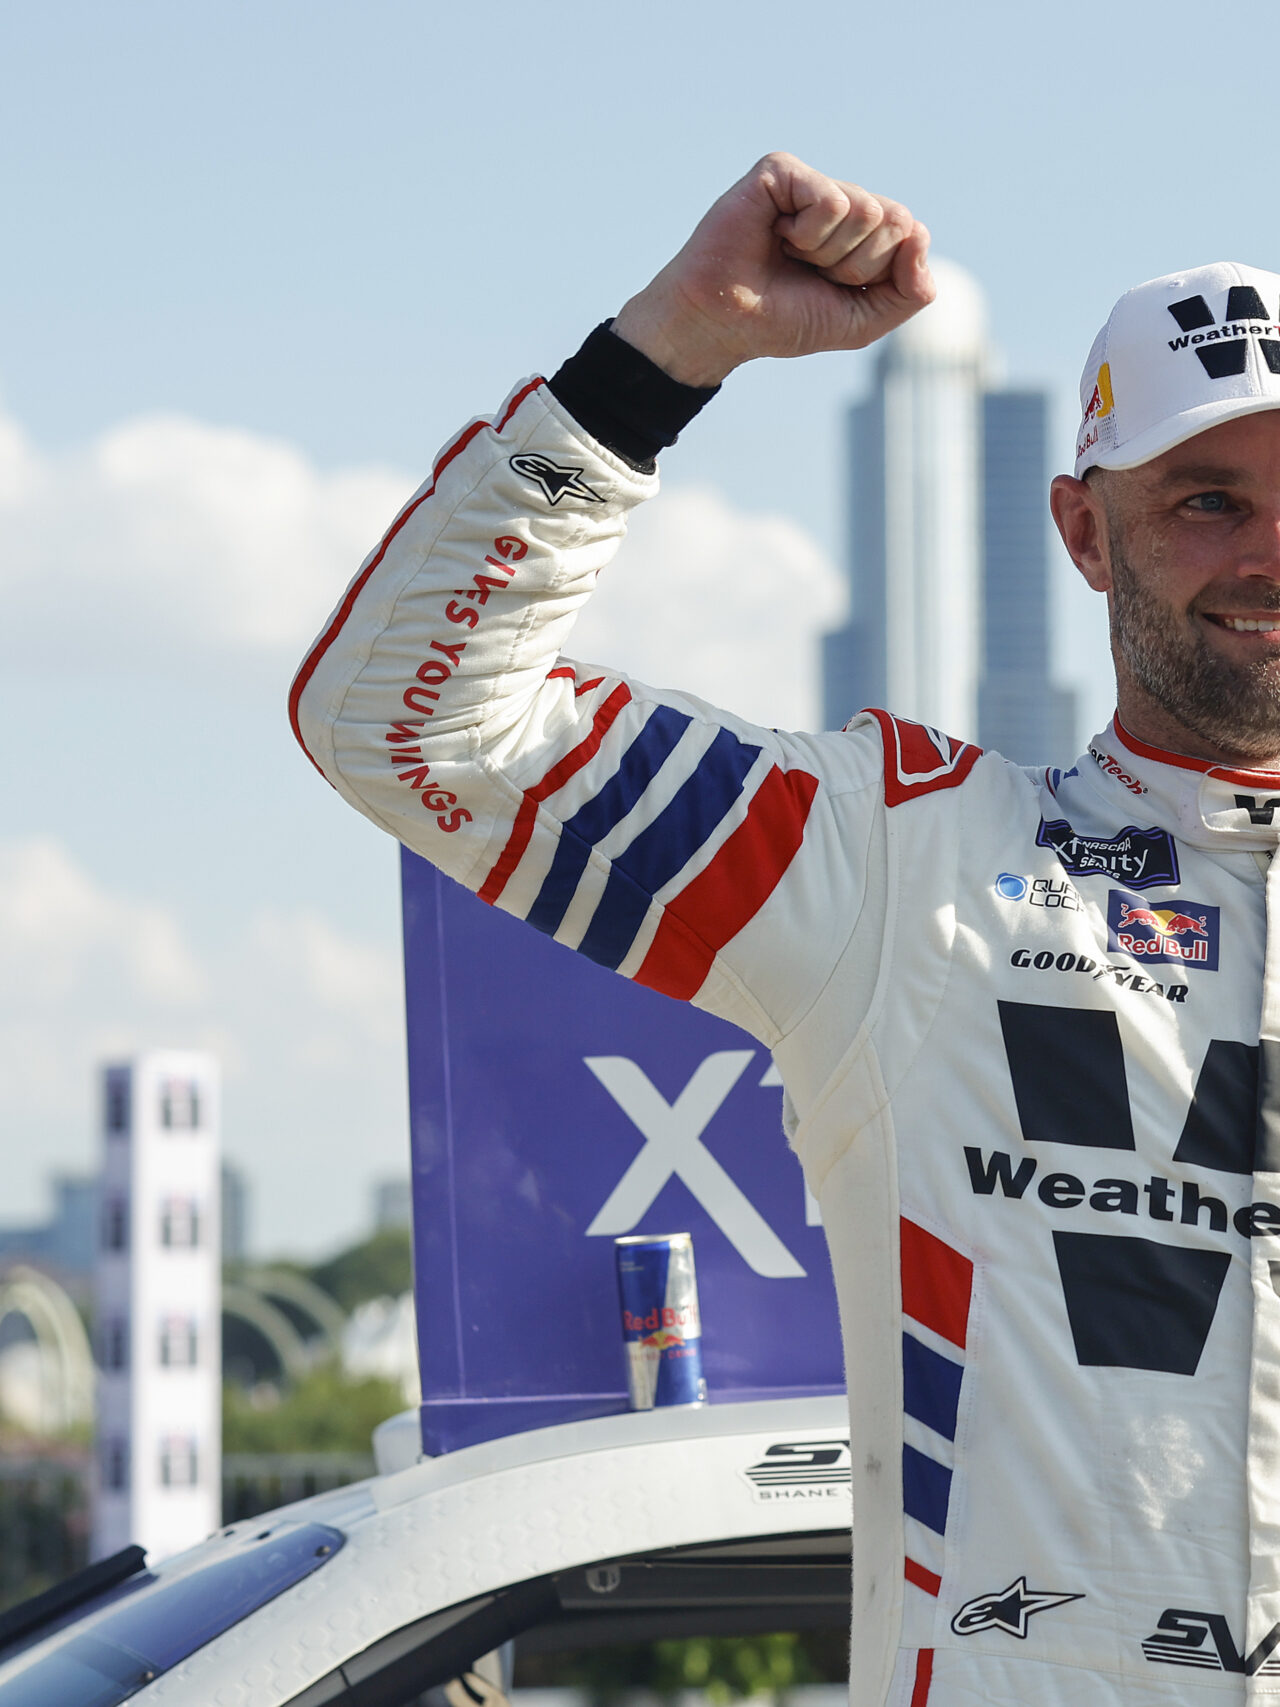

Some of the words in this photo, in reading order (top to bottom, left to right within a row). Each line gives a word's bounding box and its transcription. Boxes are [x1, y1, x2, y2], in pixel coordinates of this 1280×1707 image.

[444, 535, 529, 629] GIVES
[402, 639, 468, 716] YOU
[385, 721, 473, 833] WINGS
[1082, 837, 1132, 853] NASCAR
[1033, 879, 1080, 899] QUA
[1119, 933, 1162, 955] Red
[1164, 937, 1208, 961] Bull
[1010, 949, 1190, 1003] GOODYEAR
[760, 1487, 839, 1500] SHANE
